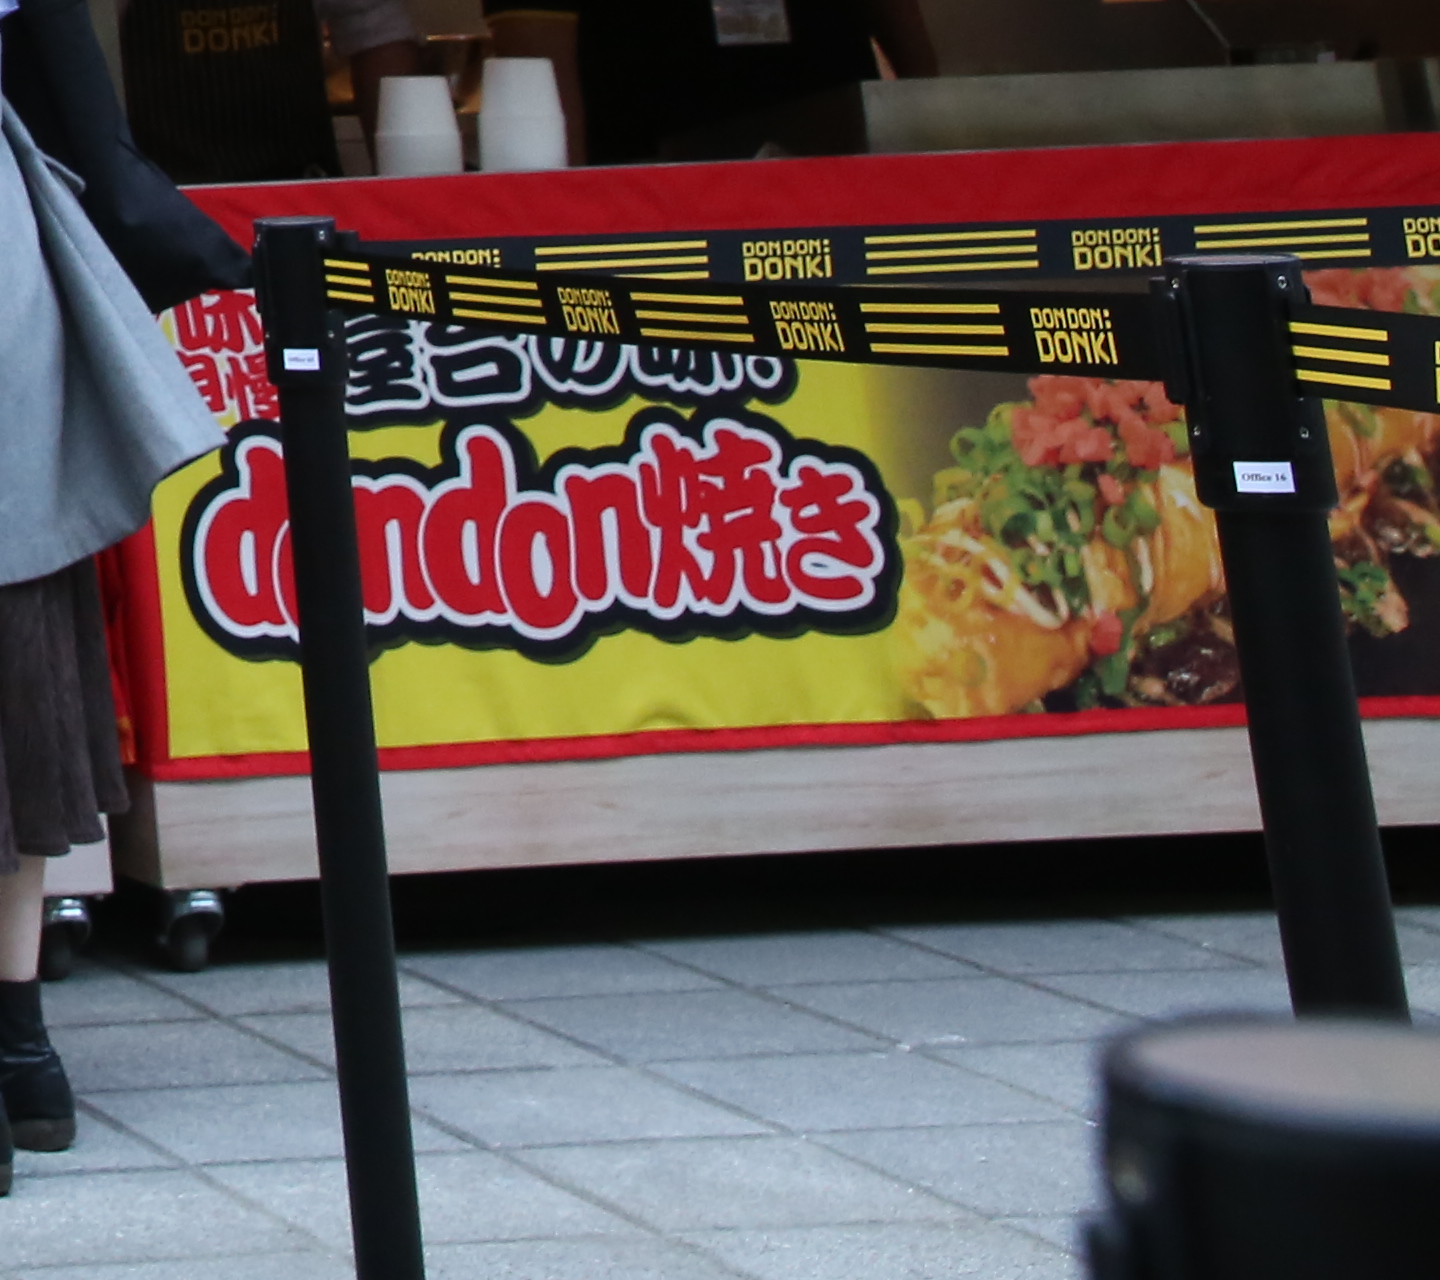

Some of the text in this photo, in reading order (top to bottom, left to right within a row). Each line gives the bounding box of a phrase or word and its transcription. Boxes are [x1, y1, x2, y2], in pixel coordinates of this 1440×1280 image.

[742, 240, 781, 258] DON
[1072, 229, 1110, 247] DON
[743, 255, 834, 282] DONKI
[1073, 244, 1162, 270] DONKI
[388, 287, 436, 314] DONKI
[770, 301, 801, 321] DON
[562, 305, 621, 335] DONKI
[1030, 307, 1064, 330] DON
[775, 321, 845, 352] DONKI
[1034, 330, 1119, 365] DONKI
[1241, 472, 1272, 482] Office
[196, 421, 884, 638] dndon焼き
